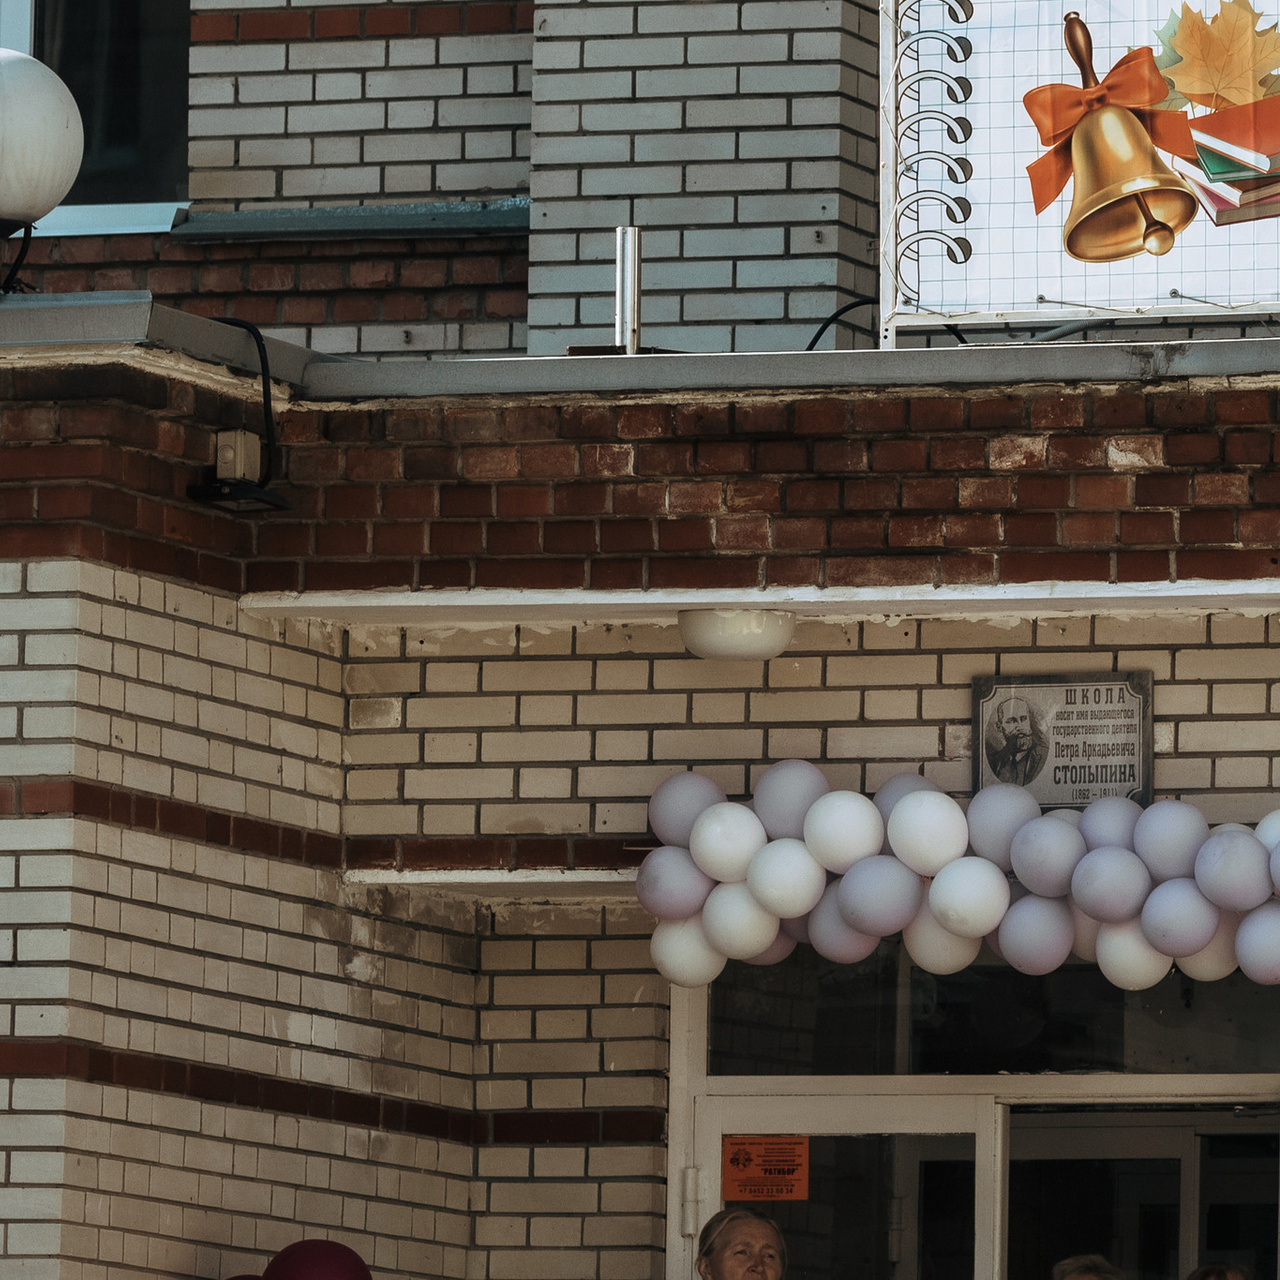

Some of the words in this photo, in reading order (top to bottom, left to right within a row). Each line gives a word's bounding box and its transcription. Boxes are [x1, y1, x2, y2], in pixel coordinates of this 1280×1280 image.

[1065, 687, 1126, 705] ШКОЛА
[1055, 709, 1074, 721] носит
[1075, 709, 1089, 720] имя
[1090, 708, 1135, 721] выдающегося
[1052, 725, 1110, 738] государственного
[1111, 723, 1138, 735] деятеля
[1054, 741, 1080, 761] Петра
[1081, 741, 1135, 760] Аркадьевича
[1053, 764, 1137, 785] СТОЛЫПИНА
